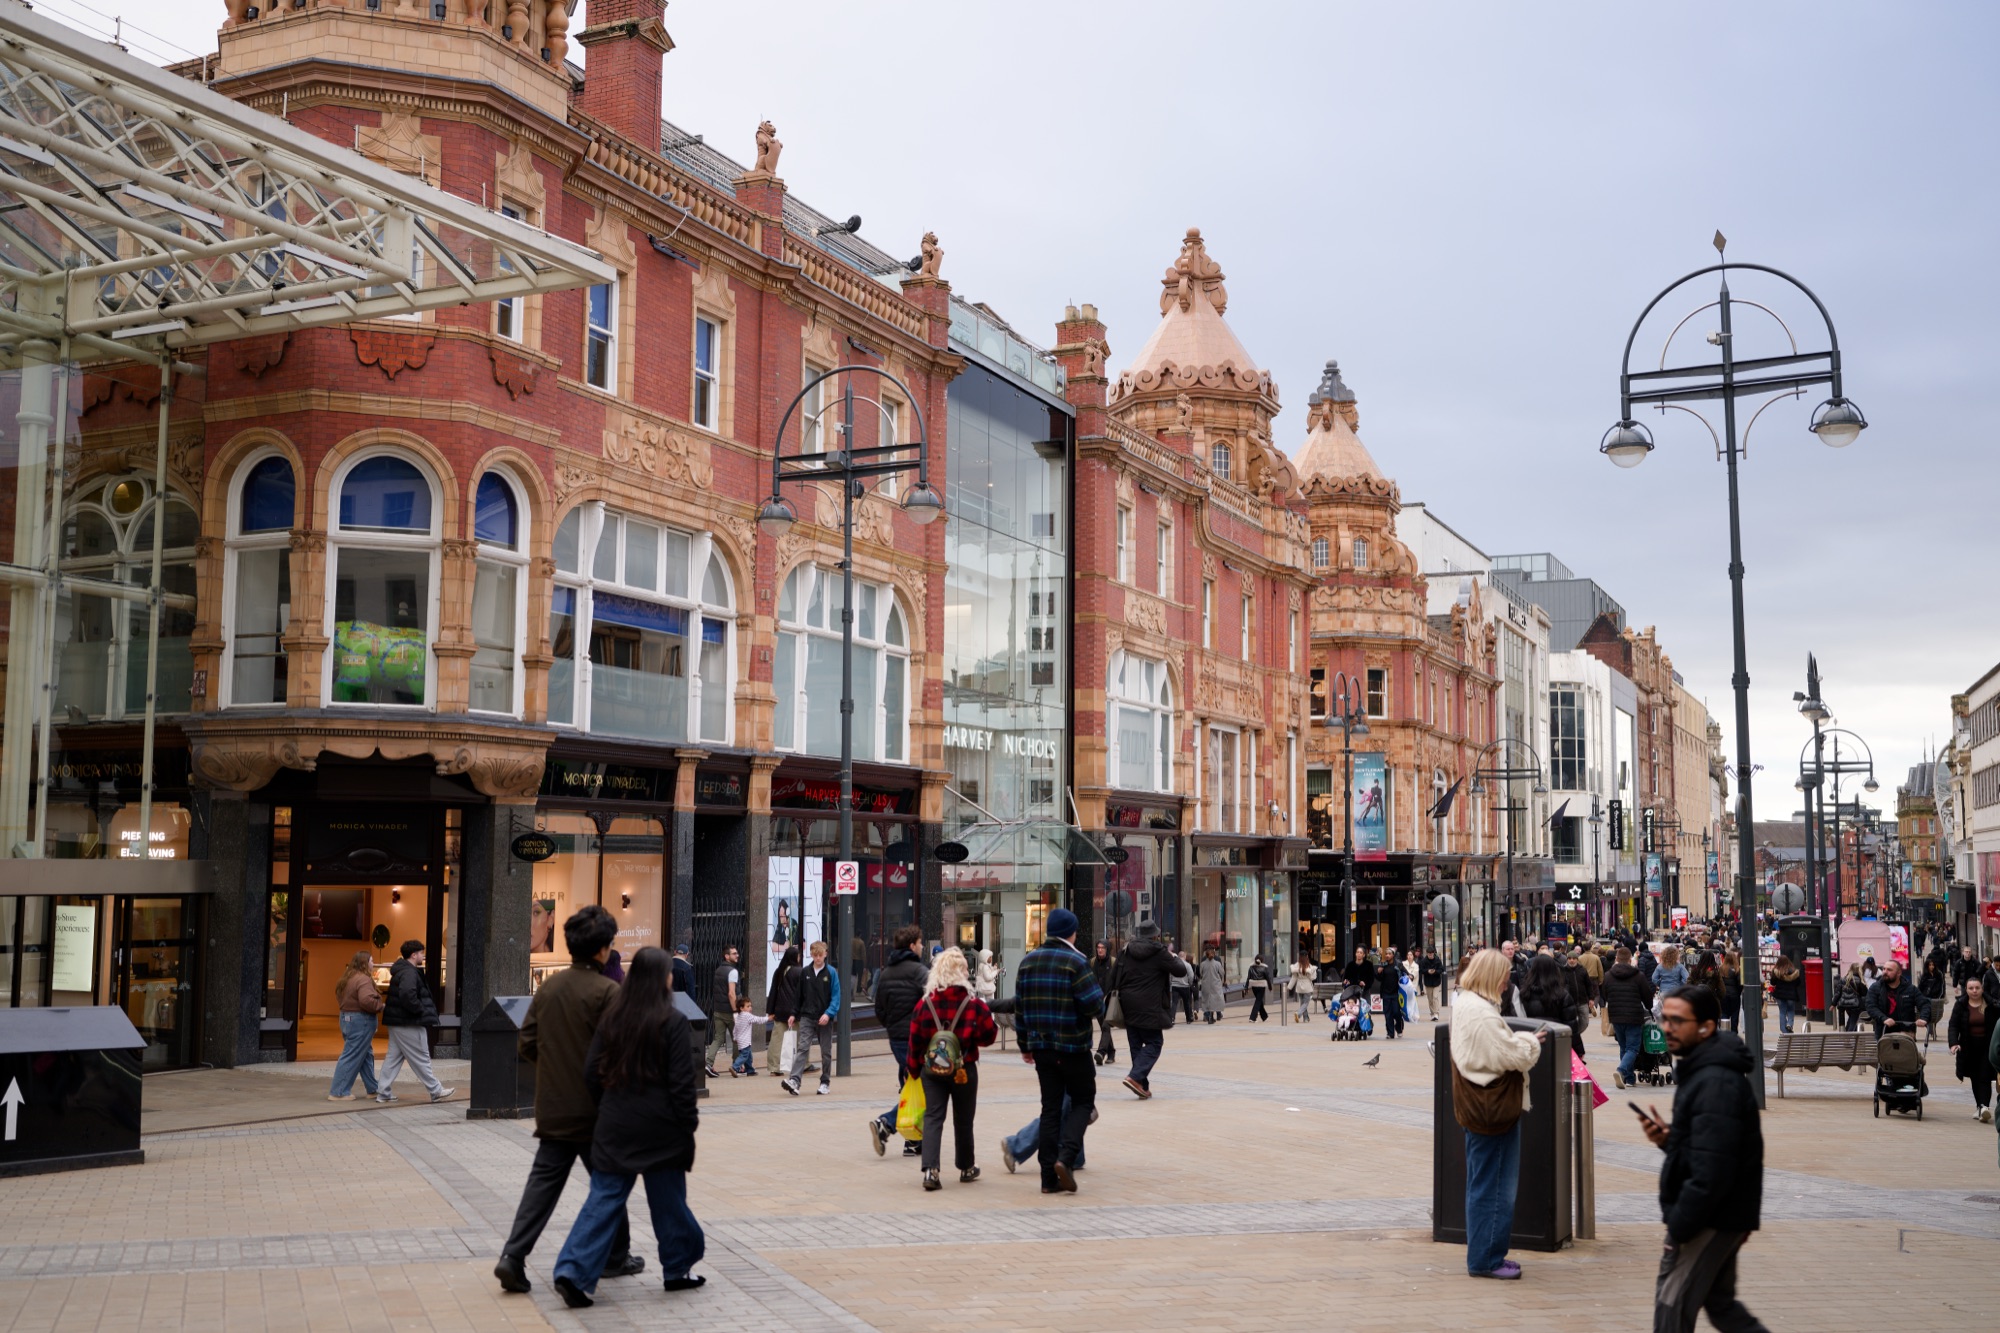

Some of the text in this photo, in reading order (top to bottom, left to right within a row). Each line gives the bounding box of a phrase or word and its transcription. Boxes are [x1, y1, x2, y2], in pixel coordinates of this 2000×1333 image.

[943, 725, 1056, 759] HARVEY NICHOLS
[51, 763, 100, 778] MONICA
[563, 772, 647, 790] MONICA VINADER
[805, 788, 840, 803] HARVEY
